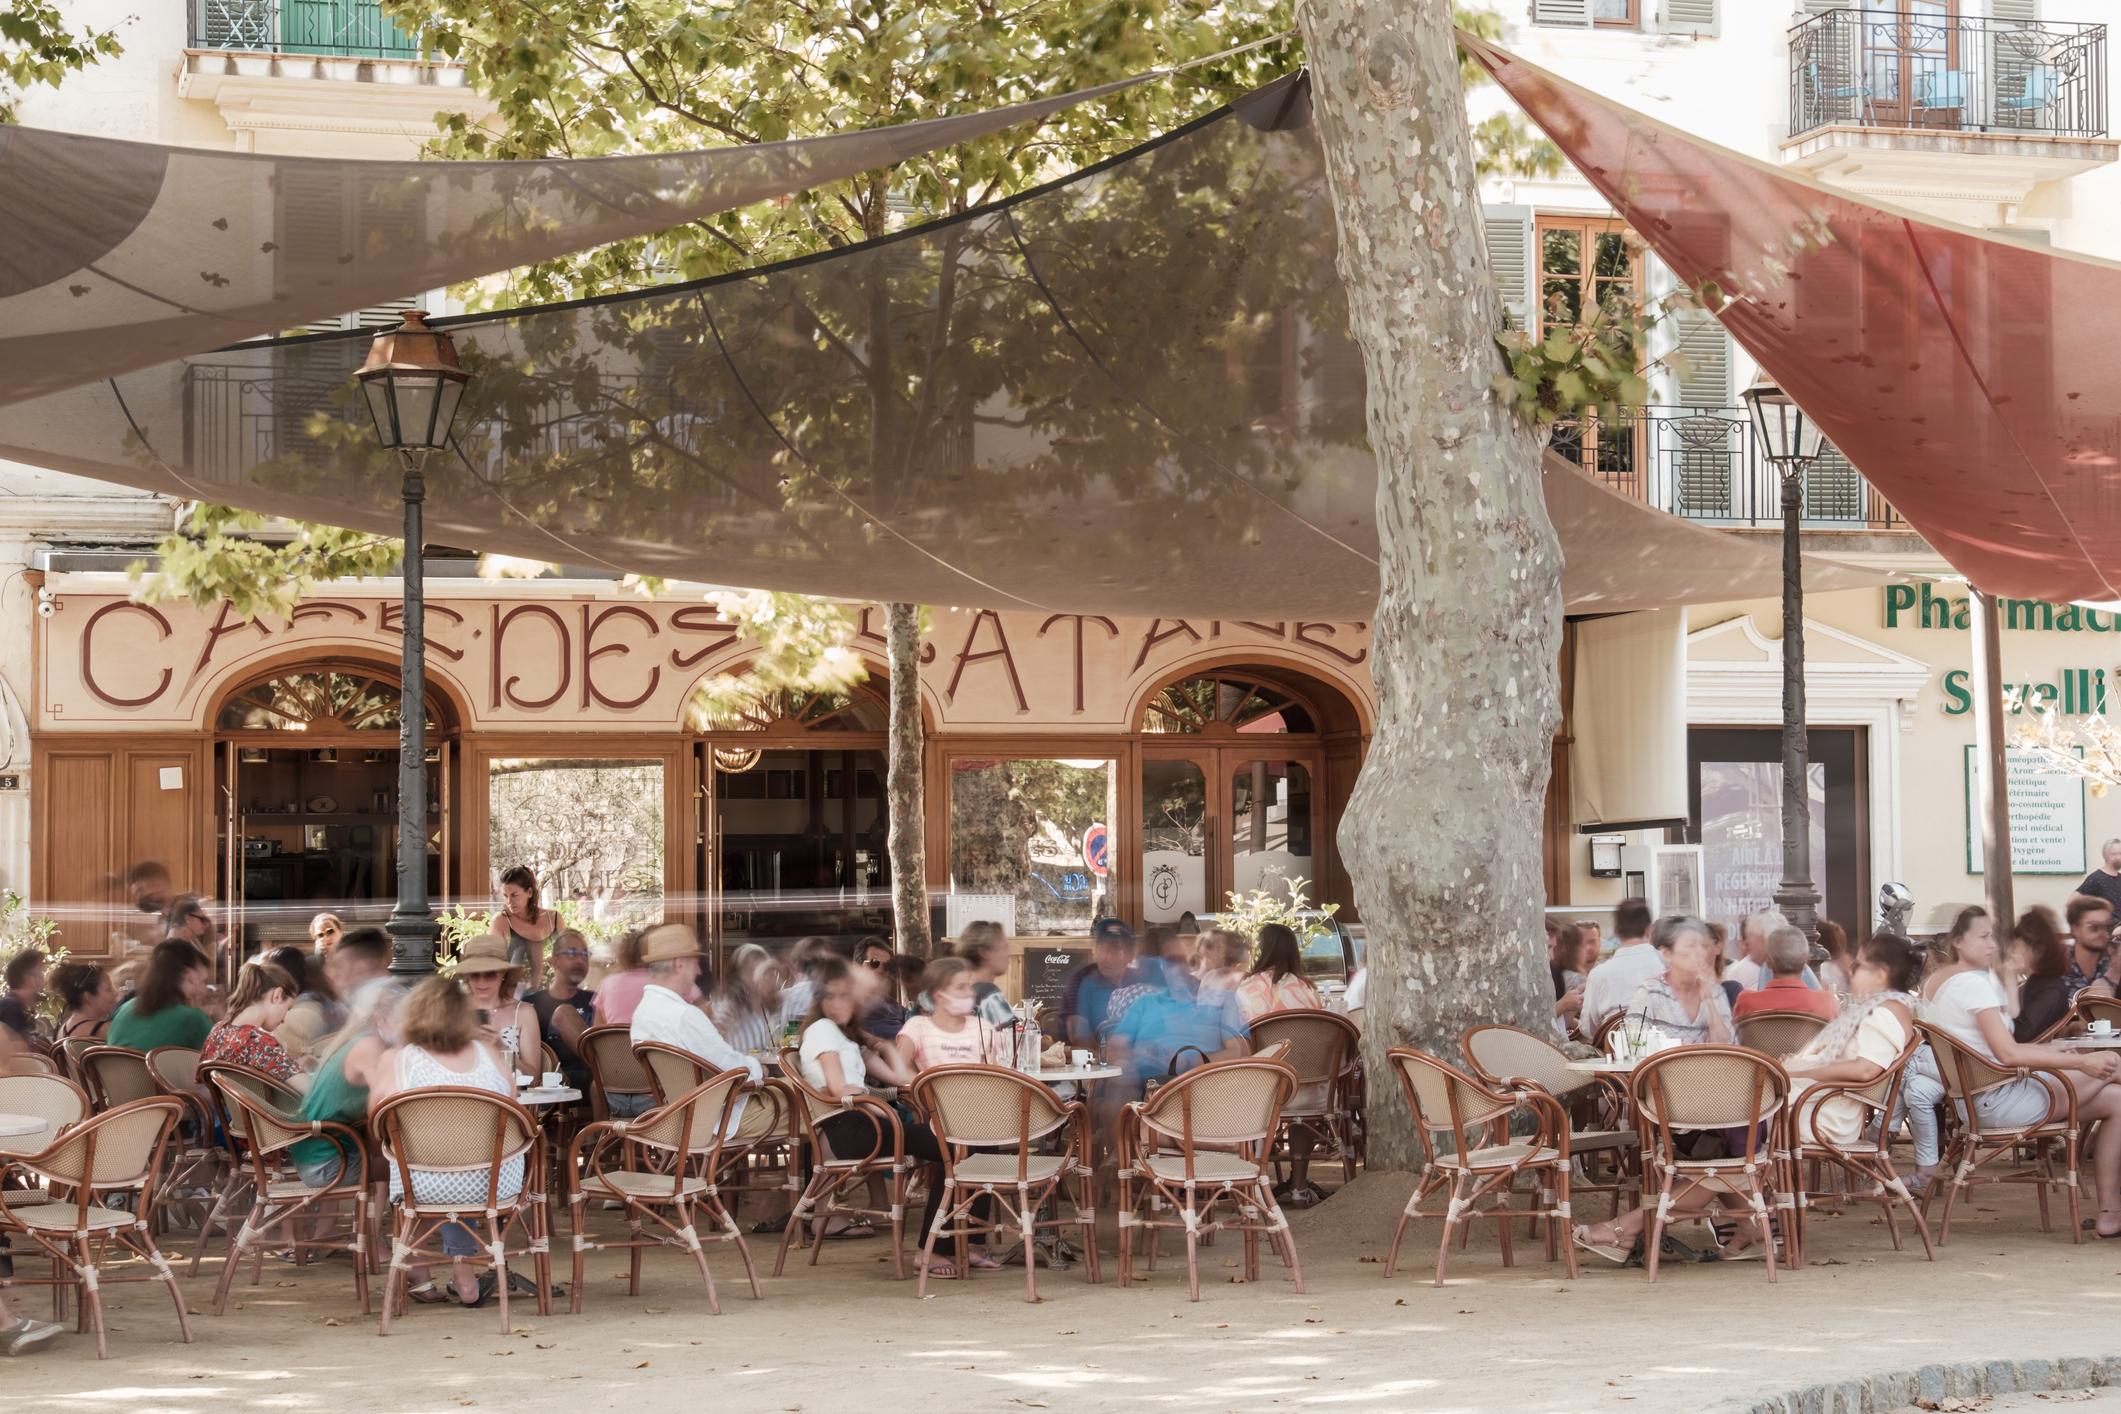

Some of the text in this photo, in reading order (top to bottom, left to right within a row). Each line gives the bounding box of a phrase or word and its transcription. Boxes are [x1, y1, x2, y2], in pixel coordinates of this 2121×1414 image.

[1886, 582, 2121, 632] Phamac
[493, 603, 741, 709] DES
[1945, 668, 2106, 715] Svelli
[5, 777, 12, 787] 5
[2008, 789, 2050, 797] étérinaire
[2008, 801, 2066, 810] o-cosmétique
[2009, 813, 2051, 822] rthopédie
[2009, 824, 2063, 832] ériel médical
